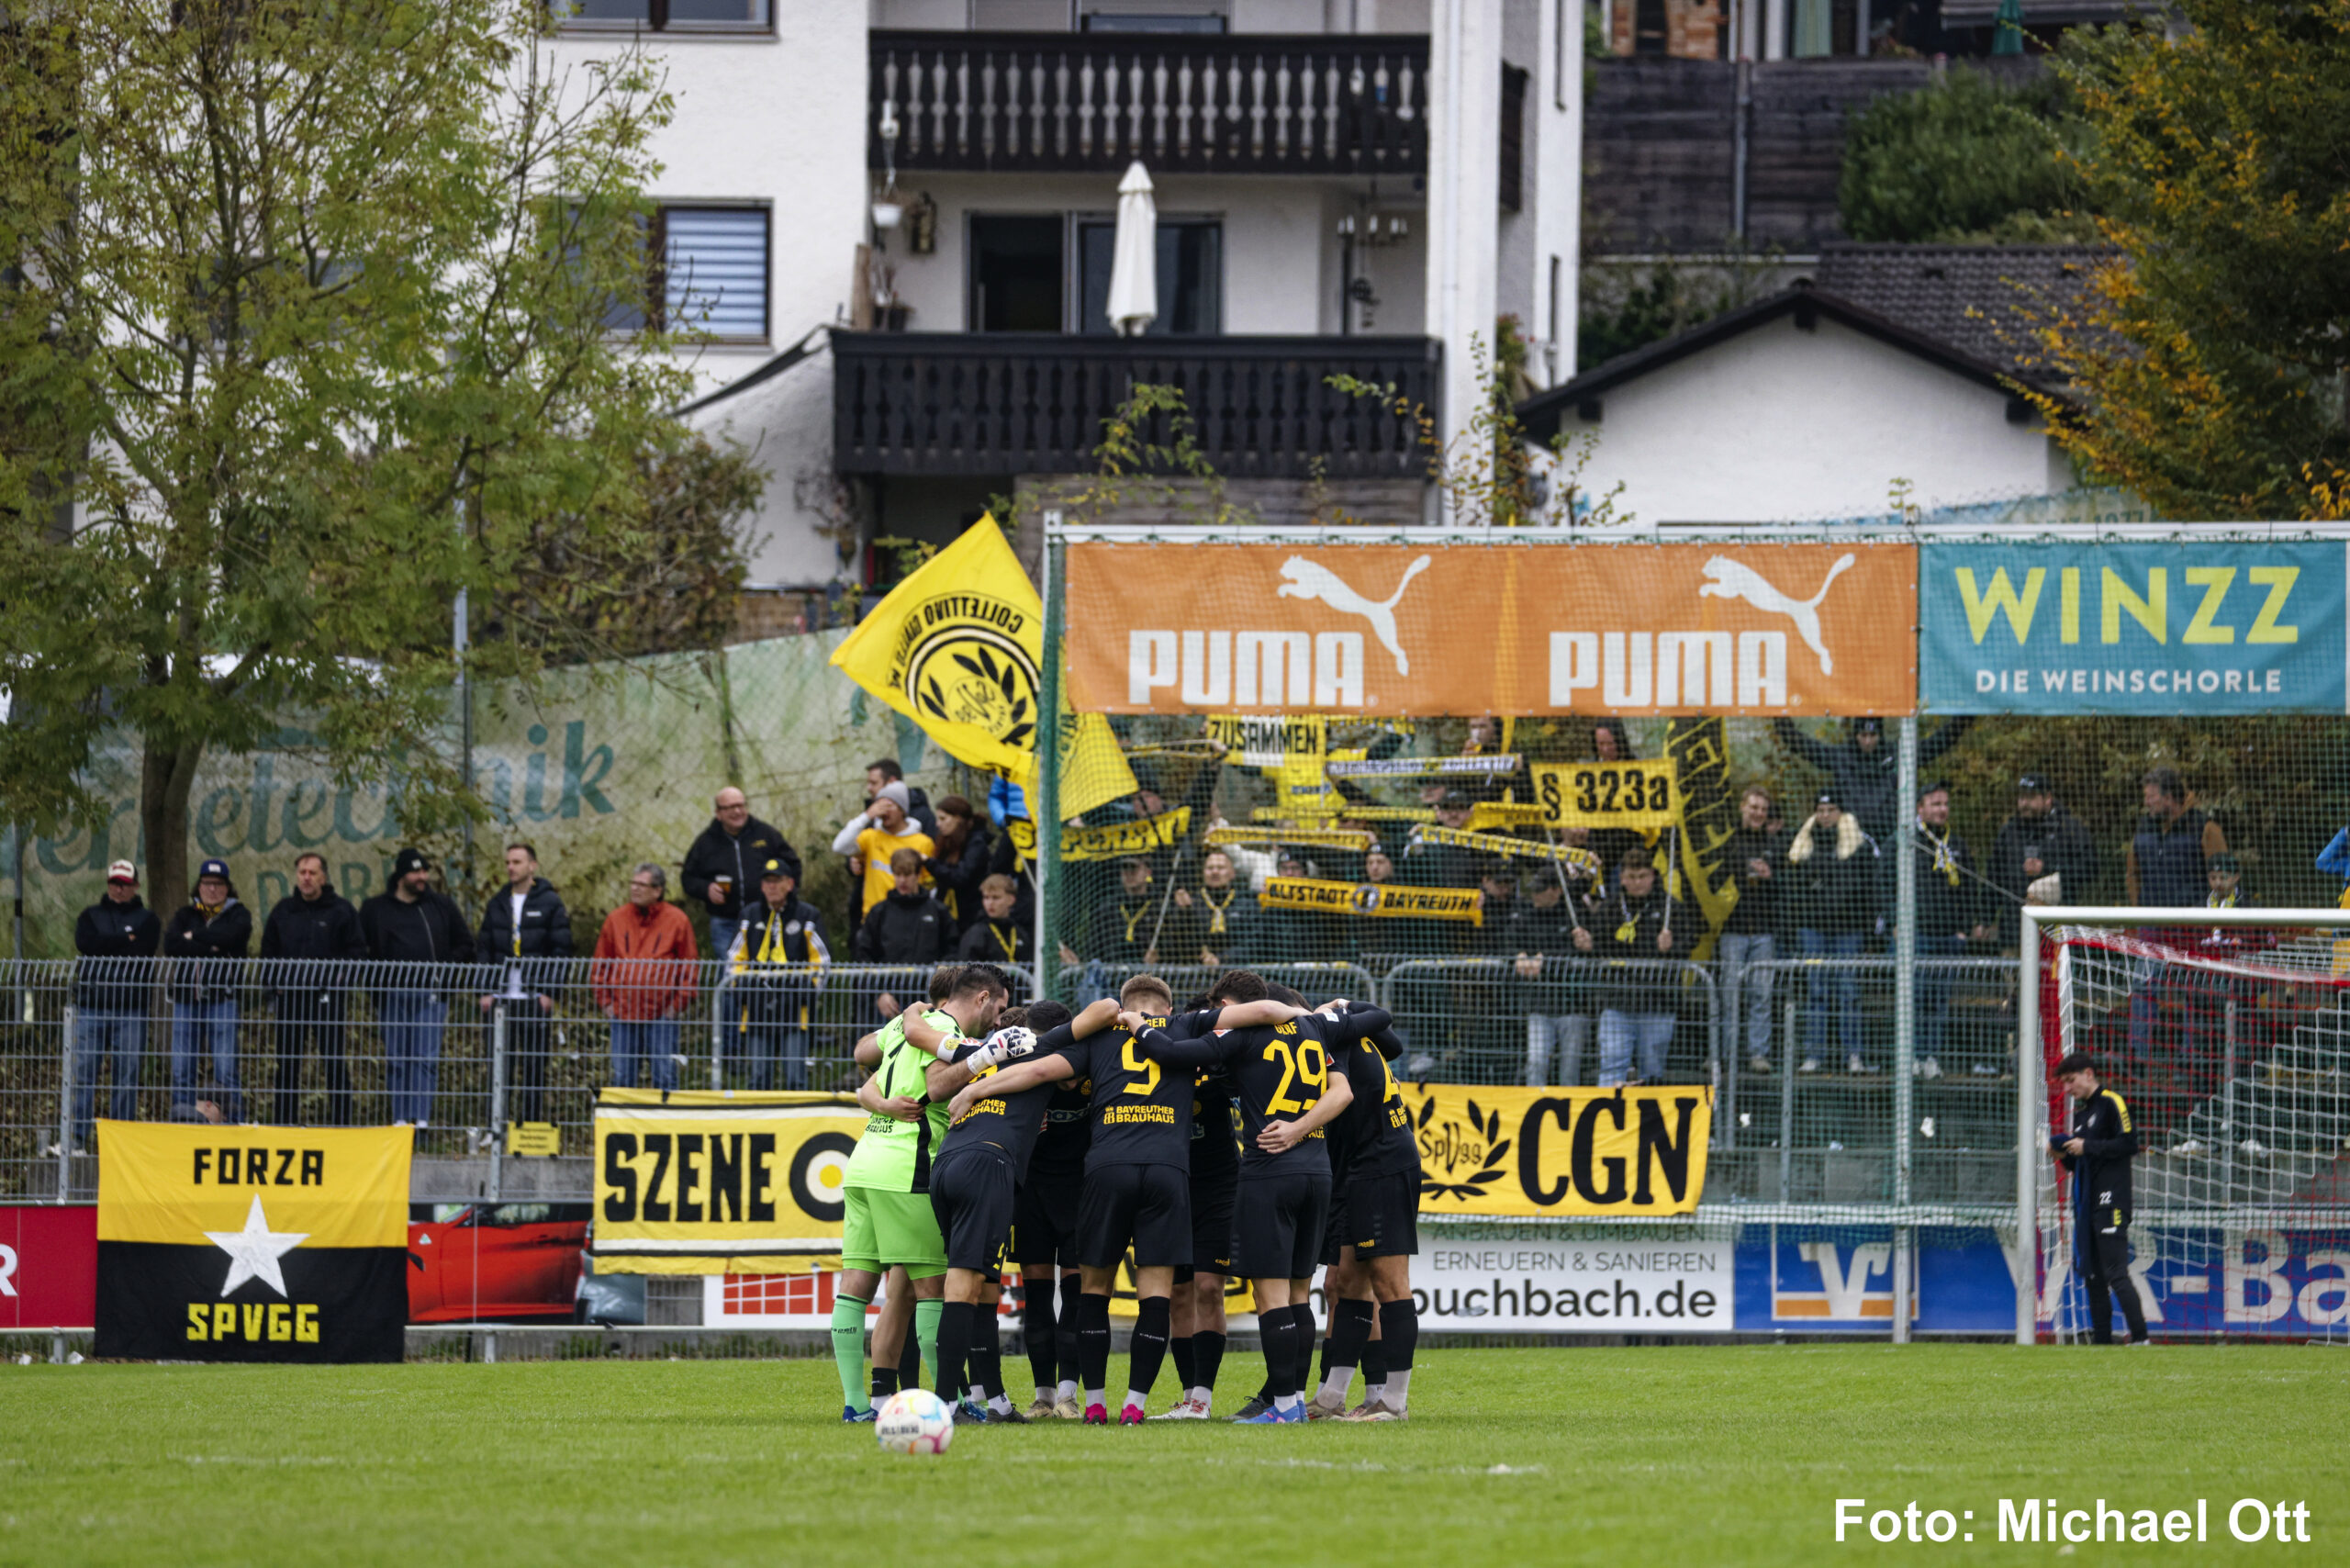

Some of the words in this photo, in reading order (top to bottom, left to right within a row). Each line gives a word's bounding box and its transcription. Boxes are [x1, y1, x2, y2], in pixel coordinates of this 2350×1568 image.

[1954, 566, 2301, 645] WINZZ
[1128, 630, 1364, 707] PUMA
[1549, 631, 1788, 708] PUMA
[1975, 668, 2029, 693] DIE
[2042, 668, 2282, 693] WEINSCHORLE
[1208, 720, 1318, 755] ZUSAMMEN
[1574, 769, 1671, 813] 323a
[1269, 882, 1348, 905] ALTSTADT
[1383, 892, 1472, 913] BAYREUTH
[1262, 1038, 1327, 1115] 29
[1115, 1104, 1175, 1115] BAYREUTHER
[1115, 1114, 1175, 1125] BRAUHAUS
[193, 1148, 325, 1186] FORZA
[1517, 1097, 1700, 1206] CGN
[603, 1132, 777, 1224] SZENE
[2098, 1191, 2112, 1204] 22
[1433, 1251, 1565, 1271] ERNEUERN
[1572, 1251, 1589, 1271] &
[1595, 1251, 1717, 1272] SANIEREN
[186, 1303, 320, 1343] SPVGG
